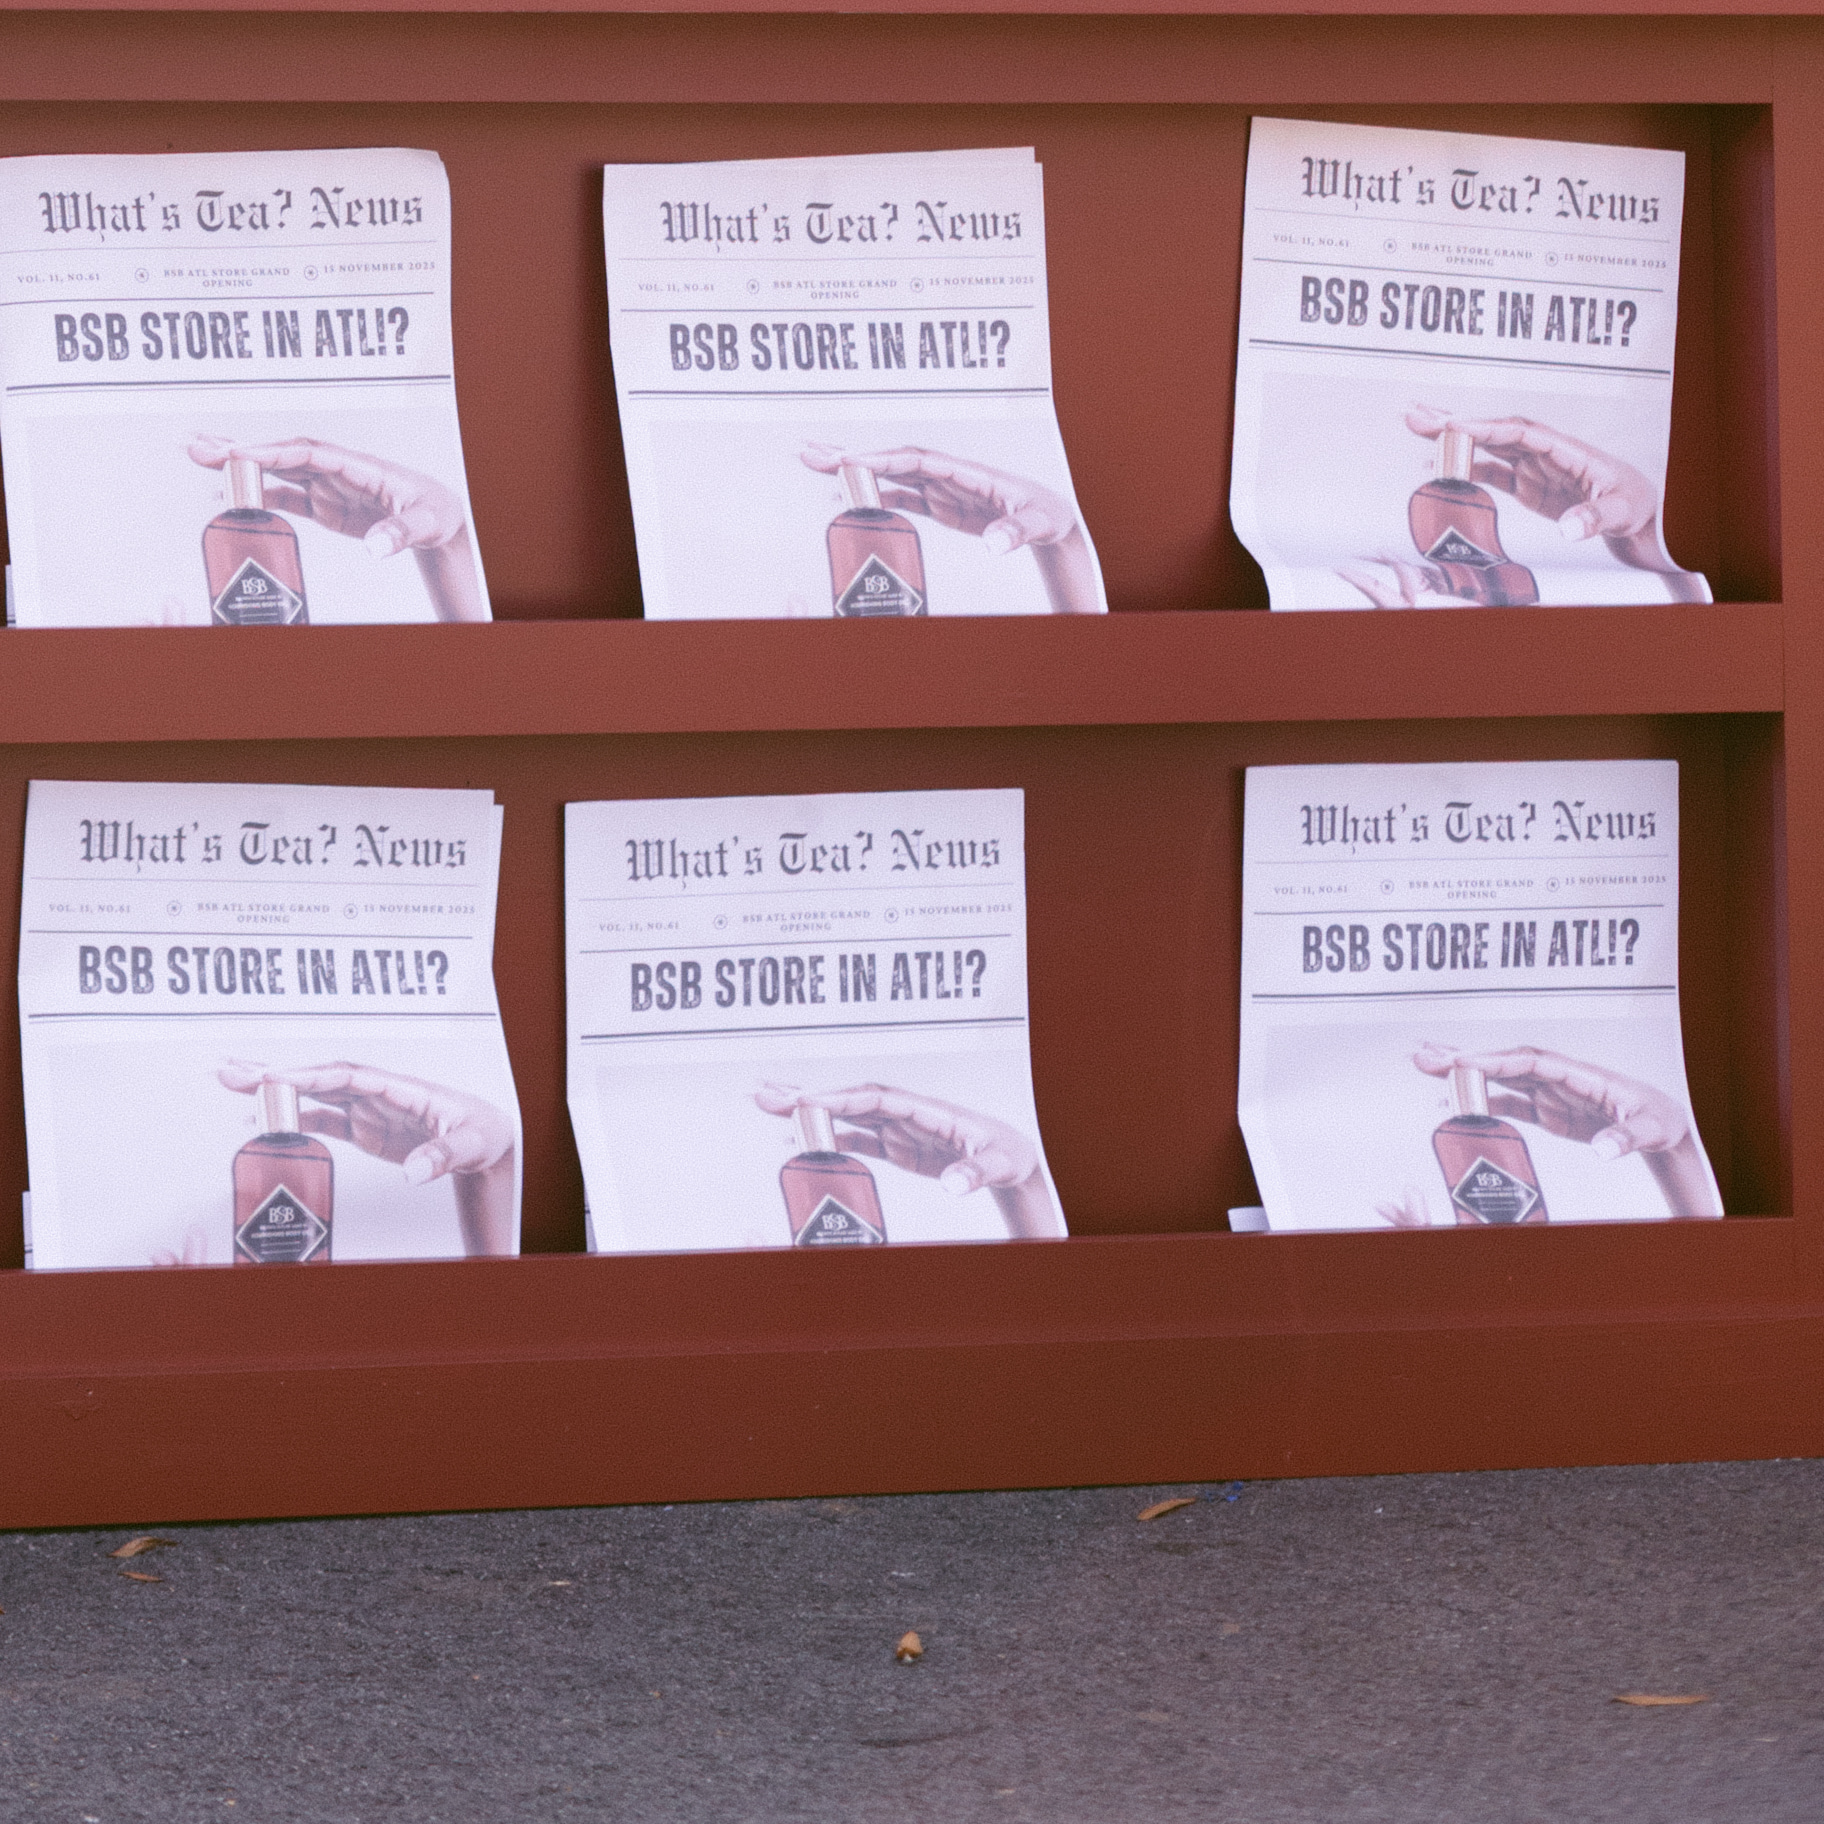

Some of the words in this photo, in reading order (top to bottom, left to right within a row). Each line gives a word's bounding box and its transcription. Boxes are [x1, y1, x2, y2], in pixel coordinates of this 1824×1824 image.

[39, 192, 181, 242] What's
[195, 189, 292, 232] Tea?
[310, 187, 423, 230] News
[1302, 157, 1434, 211] What's
[1451, 169, 1541, 213] Tea?
[1556, 177, 1660, 224] News
[660, 201, 790, 252] What's
[806, 201, 899, 244] Tea?
[915, 201, 1022, 242] News
[54, 313, 129, 362] BSB
[141, 311, 252, 360] STORE
[263, 310, 302, 357] IN
[316, 307, 409, 357] ATL!?
[1301, 275, 1369, 326] BSB
[1380, 281, 1485, 336] STORE
[1497, 290, 1533, 339] IN
[1545, 293, 1637, 346] ATL!?
[669, 323, 739, 371] BSB
[750, 321, 858, 370] STORE
[869, 322, 906, 368] IN
[919, 319, 1011, 368] ATL!?
[80, 820, 221, 873] What's
[239, 821, 336, 866] Tea?
[354, 824, 467, 868] News
[1301, 803, 1428, 854] What's
[1445, 801, 1537, 844] Tea?
[1554, 801, 1656, 842] News
[626, 836, 762, 889] What's
[779, 831, 873, 875] Tea?
[891, 829, 1001, 871] News
[80, 945, 153, 995] BSB
[167, 946, 284, 995] STORE
[297, 947, 337, 995] IN
[351, 950, 448, 995] ATL!?
[1303, 924, 1370, 973] BSB
[1383, 922, 1488, 971] STORE
[1500, 920, 1536, 969] IN
[1547, 918, 1639, 967] ATL!?
[631, 961, 702, 1012] BSB
[715, 956, 825, 1008] STORE
[839, 953, 876, 1002] IN
[890, 949, 987, 1000] ATL!?
